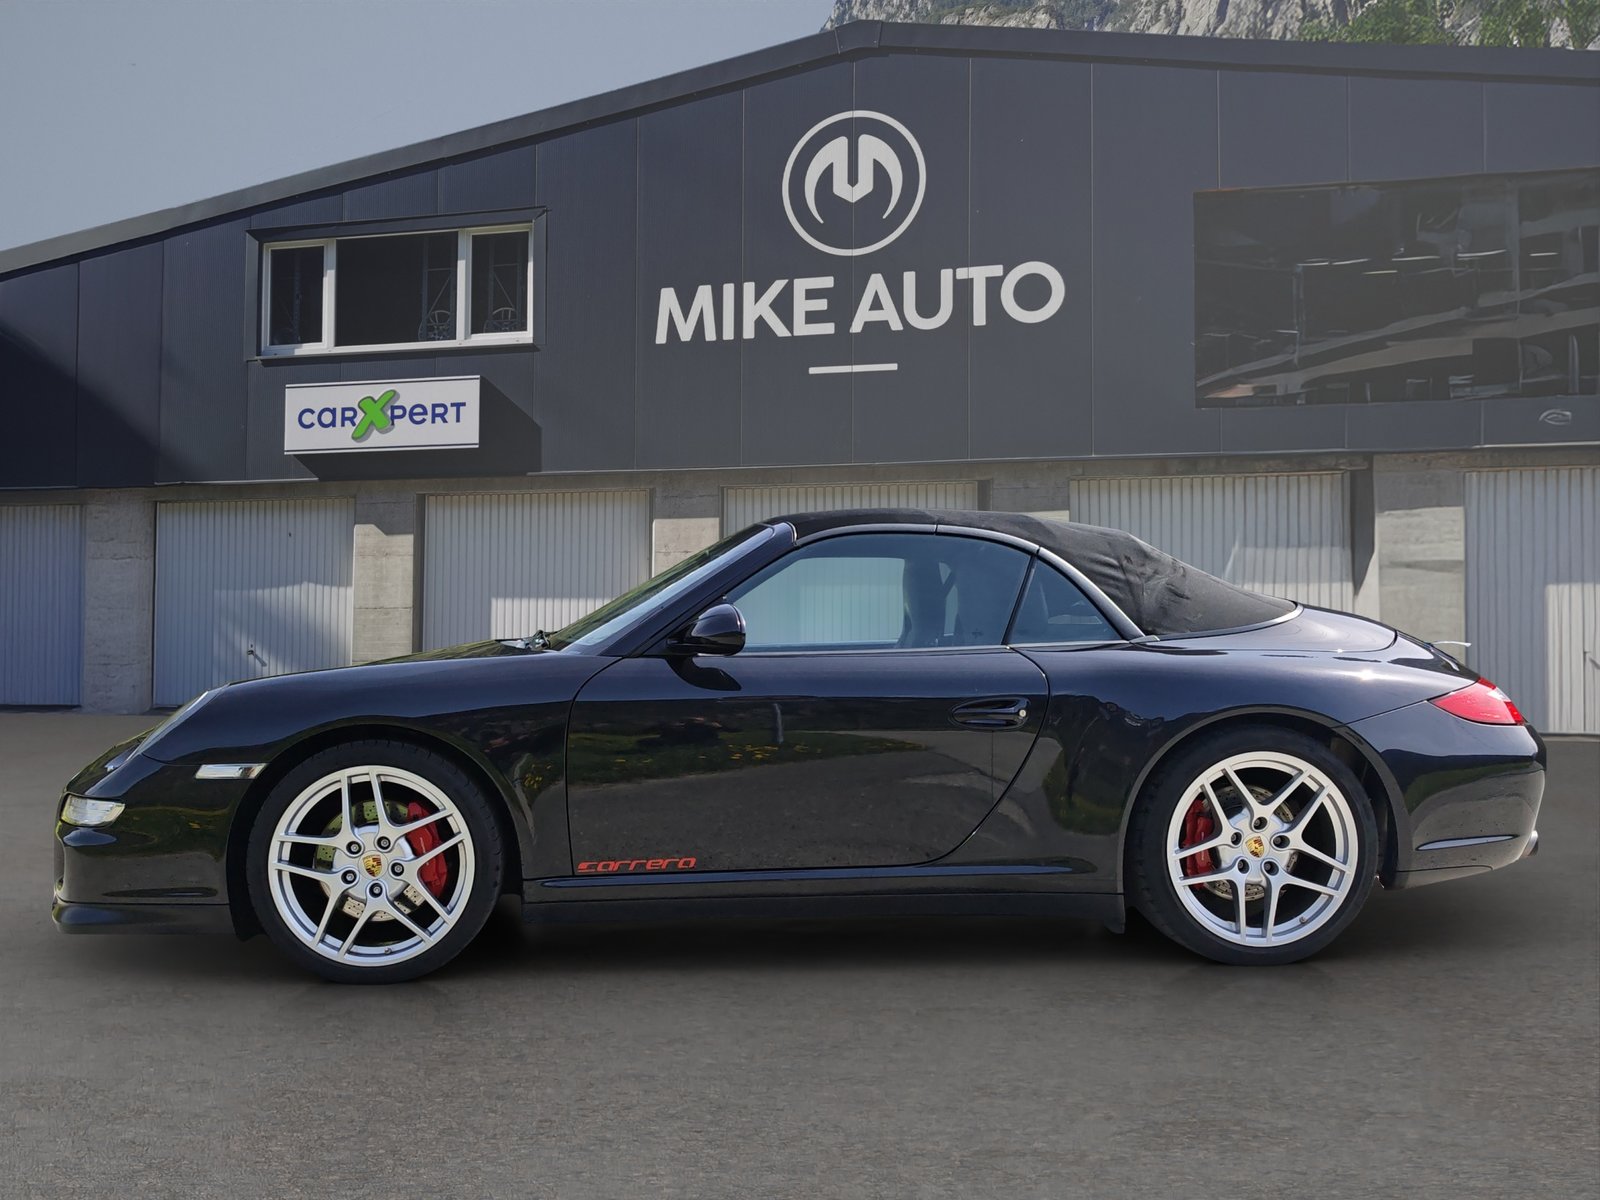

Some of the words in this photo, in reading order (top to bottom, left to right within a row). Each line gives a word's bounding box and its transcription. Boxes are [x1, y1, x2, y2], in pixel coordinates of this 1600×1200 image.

[655, 276, 835, 345] MIKE
[849, 260, 1066, 334] AUTO
[577, 857, 697, 873] carrera
